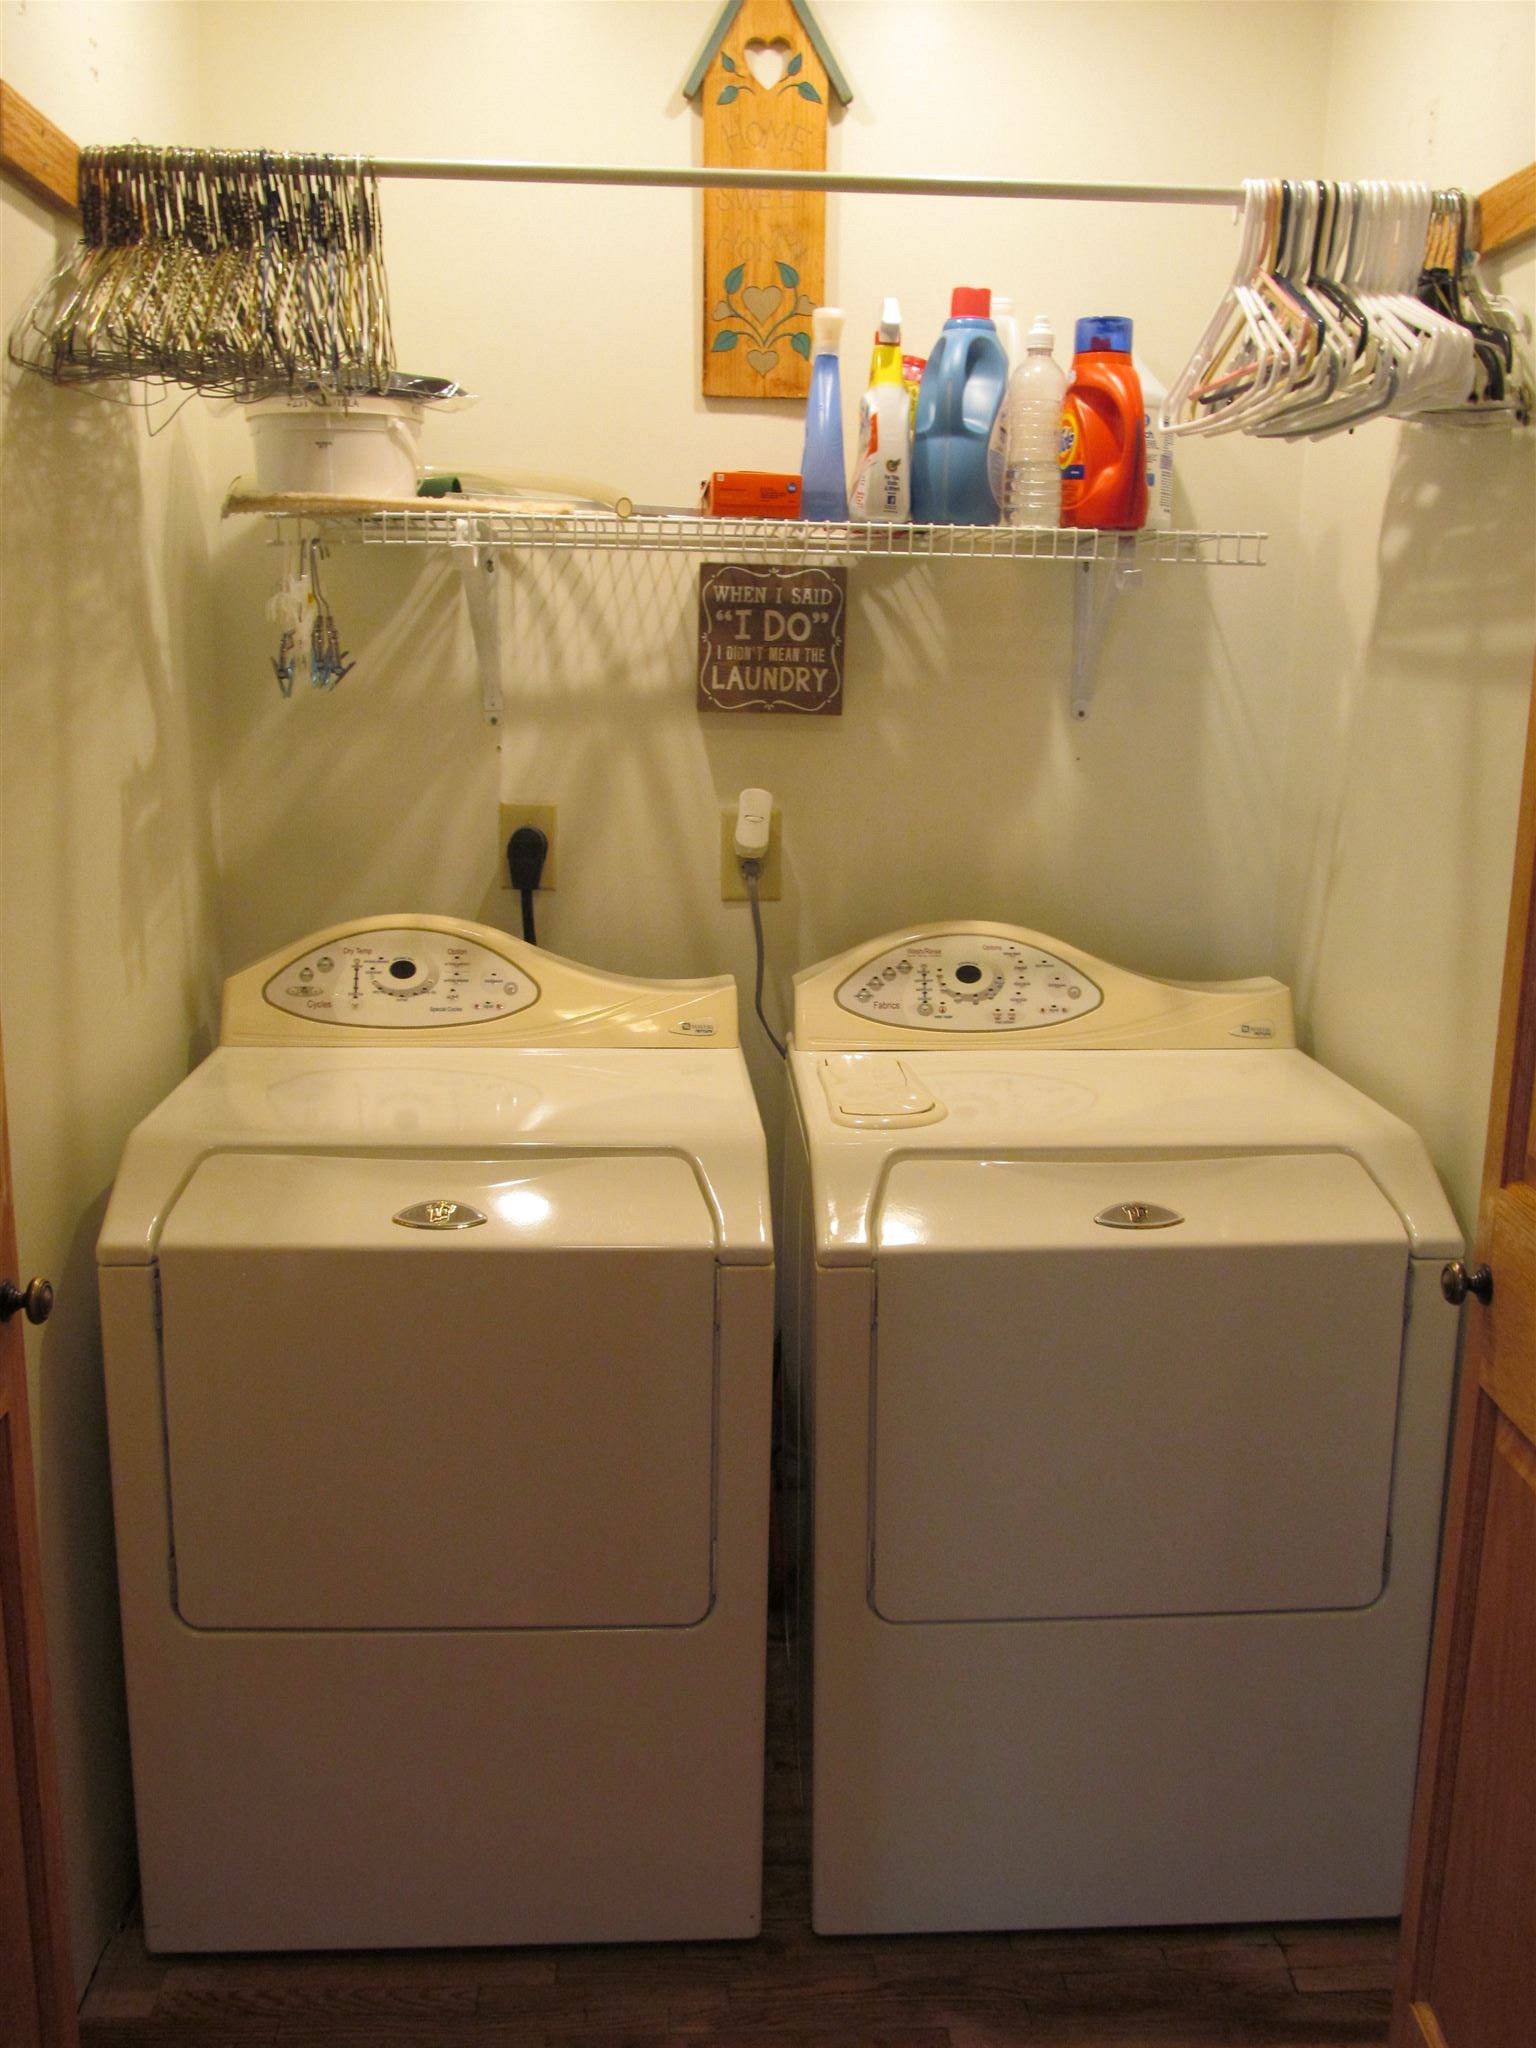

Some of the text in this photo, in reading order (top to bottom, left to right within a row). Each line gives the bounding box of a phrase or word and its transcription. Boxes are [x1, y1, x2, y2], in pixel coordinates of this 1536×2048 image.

[713, 585, 833, 605] WHEN I SAID
[716, 609, 829, 642] "I DO"
[717, 645, 825, 662] I DIDN'T MEAN THE
[711, 665, 829, 692] LAUNDRY
[306, 1000, 332, 1009] Cycles
[873, 1001, 900, 1009] Fabrics
